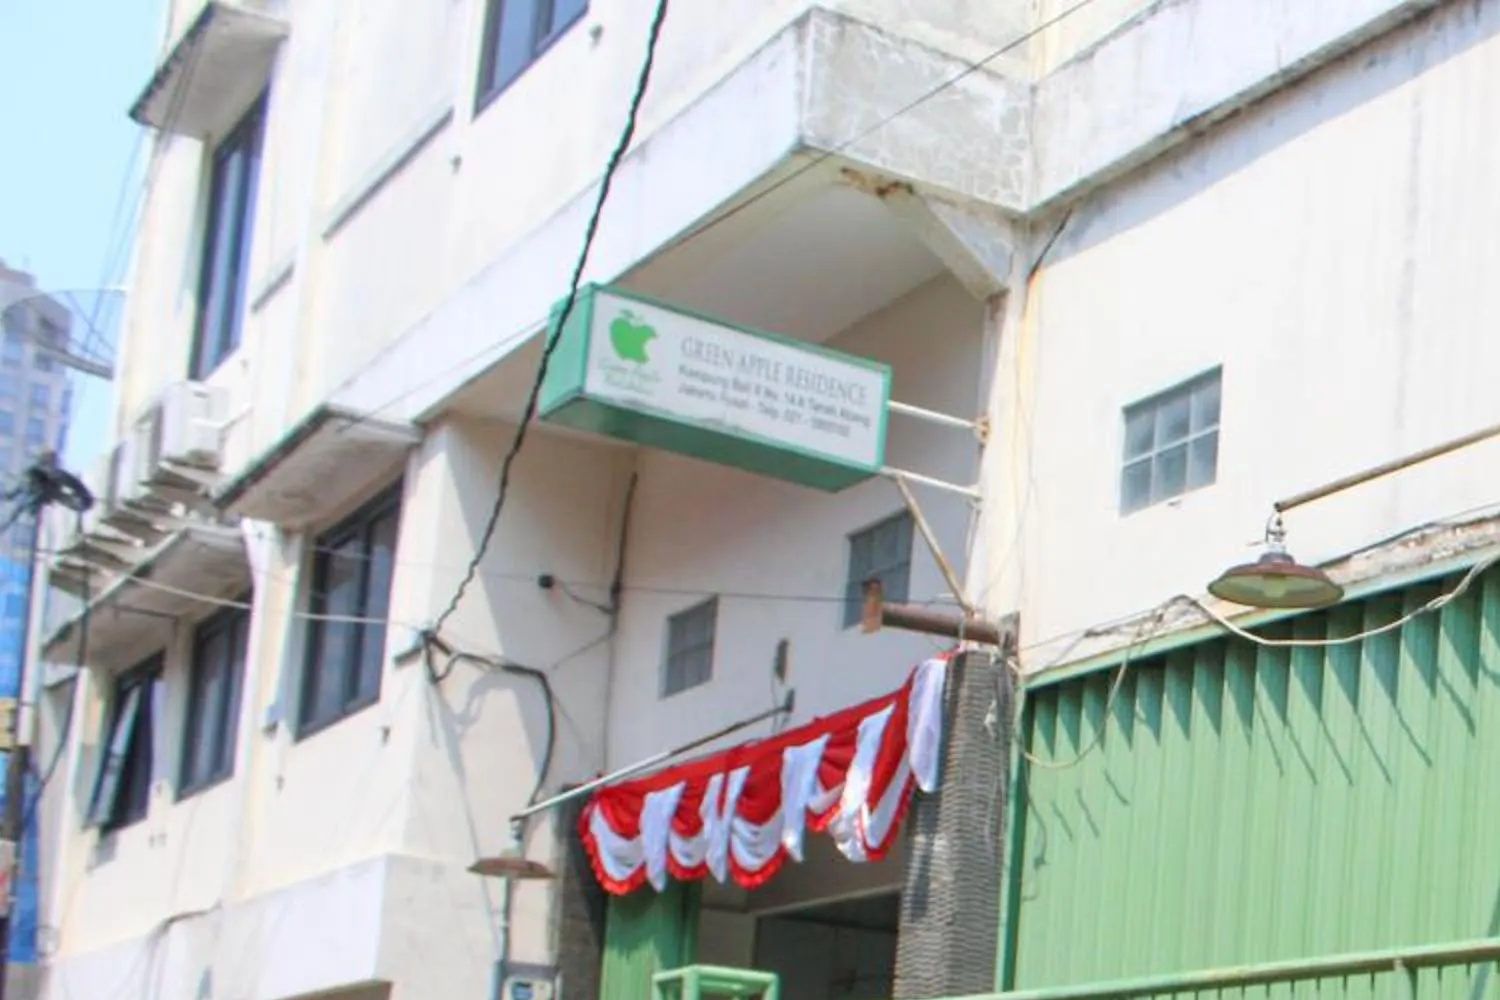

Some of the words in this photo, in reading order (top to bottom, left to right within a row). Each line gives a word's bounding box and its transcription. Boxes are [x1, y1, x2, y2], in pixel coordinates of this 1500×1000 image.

[680, 336, 734, 370] GREEN
[736, 353, 782, 384] APPLE
[784, 366, 868, 407] RESIDENCE
